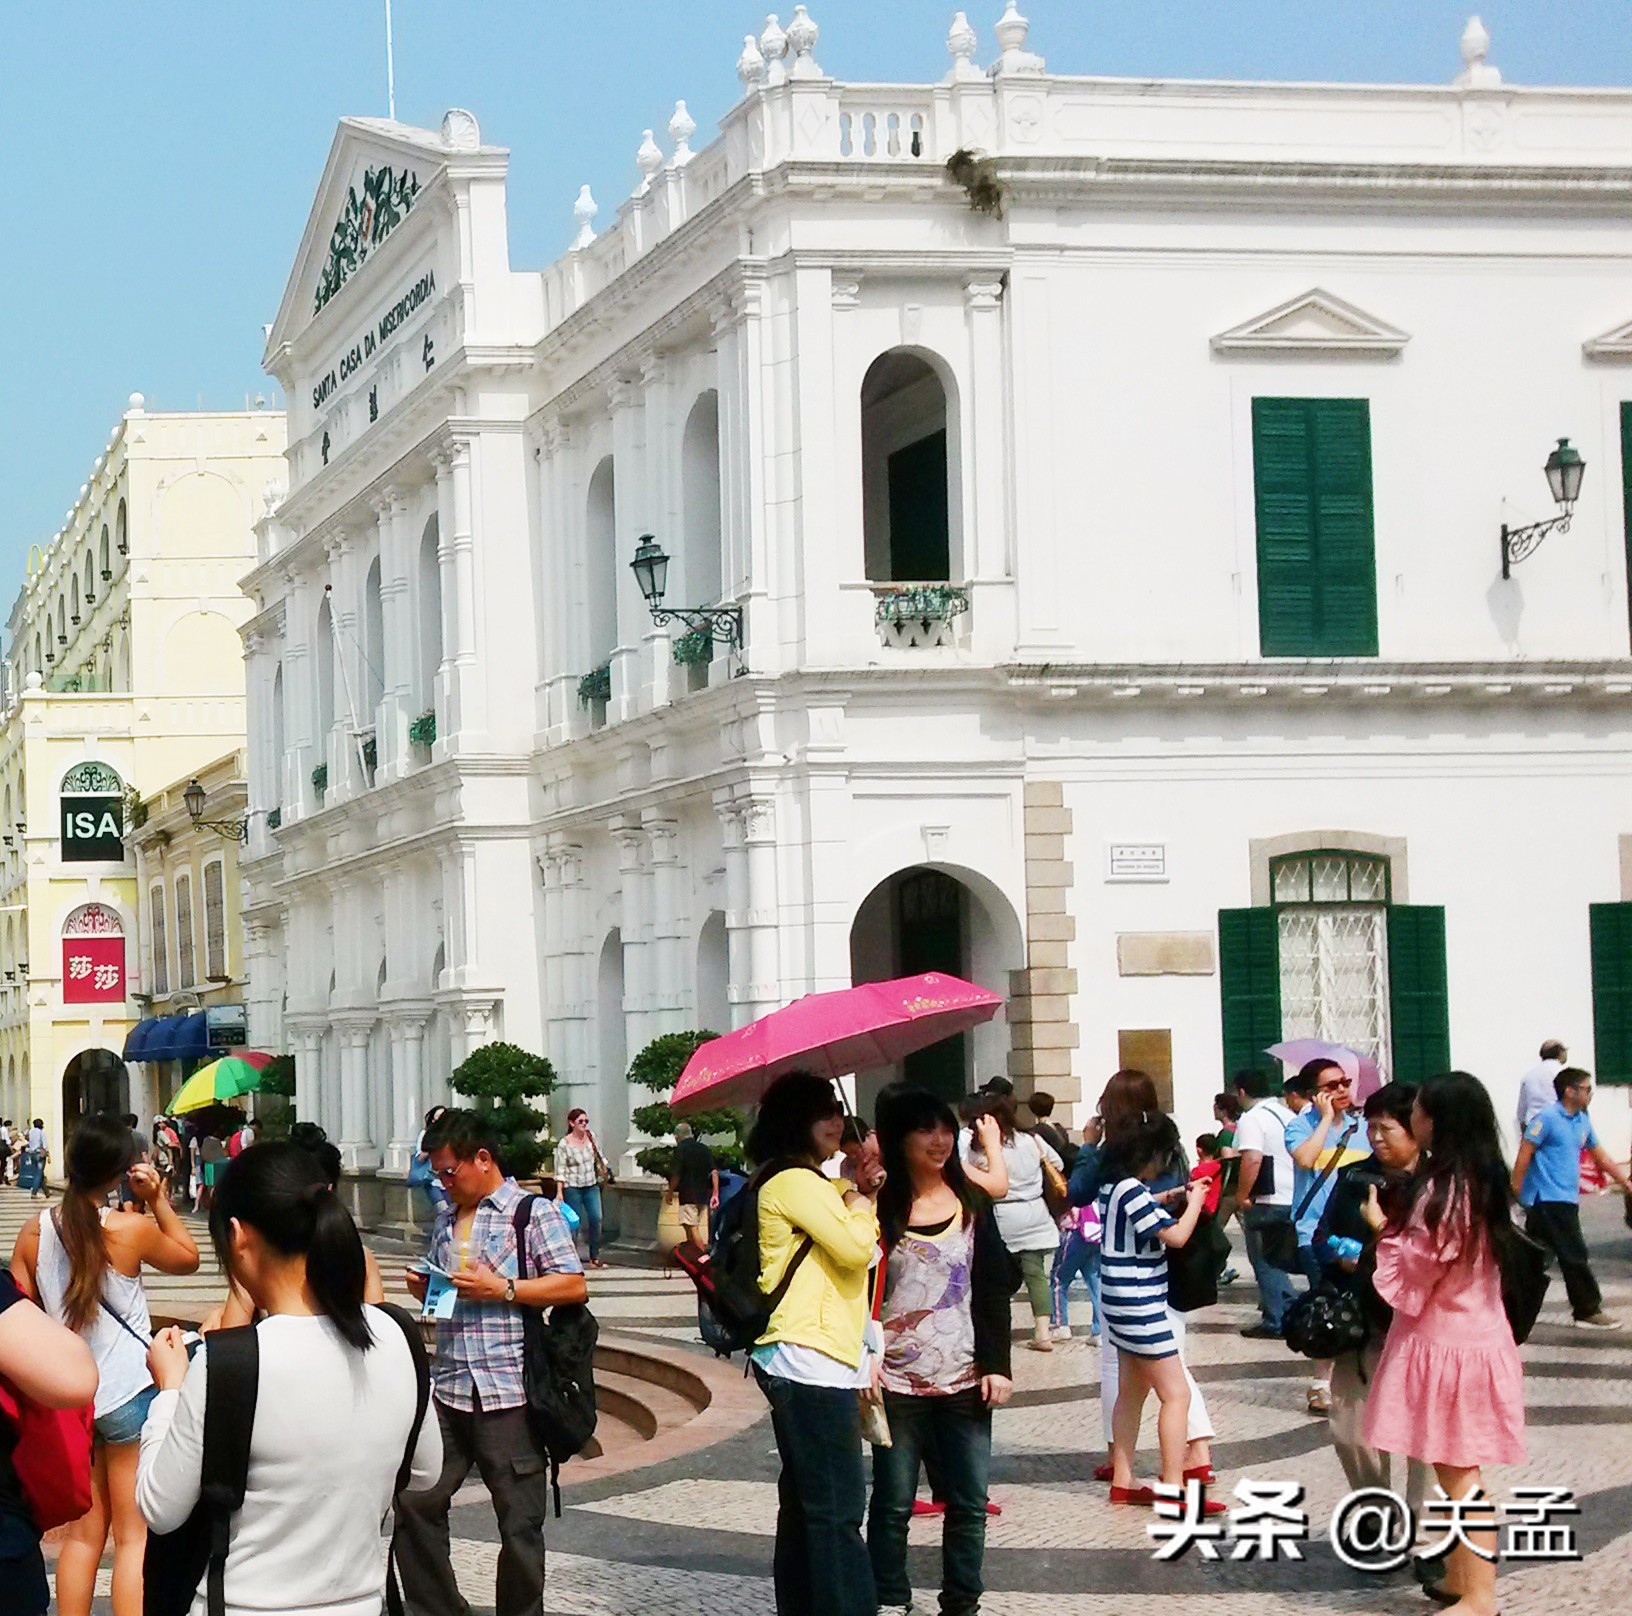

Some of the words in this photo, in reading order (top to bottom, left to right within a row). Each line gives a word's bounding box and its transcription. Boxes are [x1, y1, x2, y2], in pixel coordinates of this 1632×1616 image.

[313, 370, 338, 410] SANTA
[339, 344, 363, 382] CASA
[364, 330, 377, 359] DA
[378, 268, 436, 345] MISERICORDIA
[66, 812, 120, 839] ISA
[69, 955, 120, 990] 莎莎
